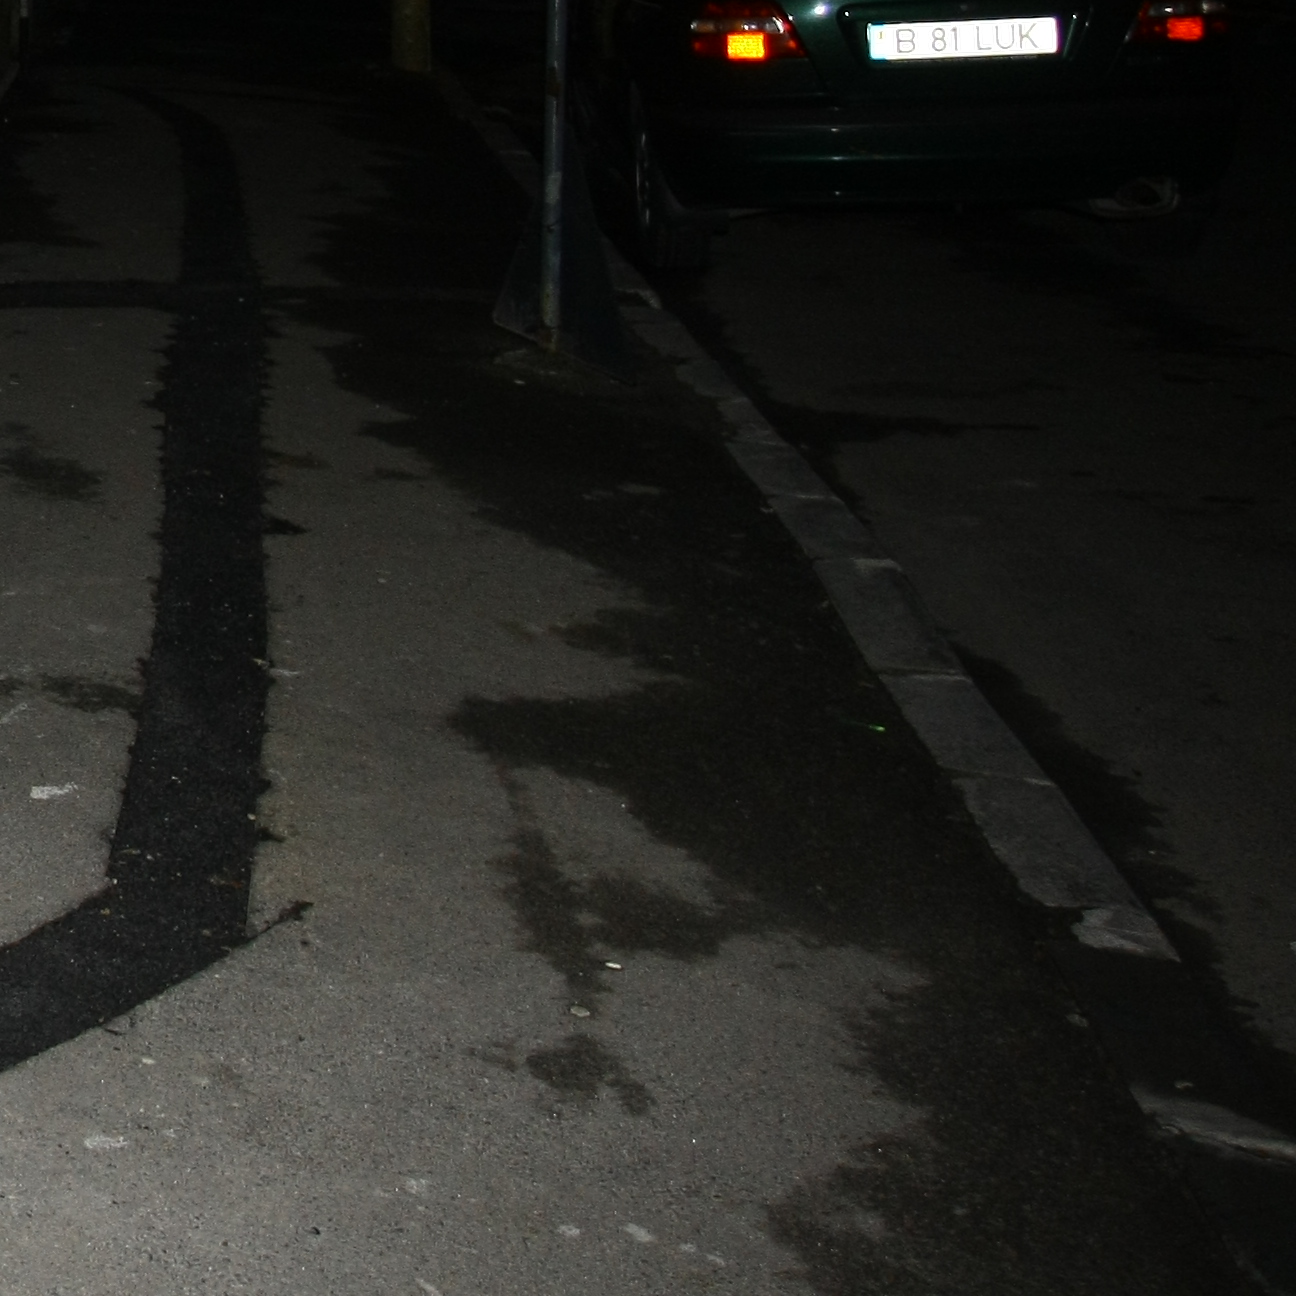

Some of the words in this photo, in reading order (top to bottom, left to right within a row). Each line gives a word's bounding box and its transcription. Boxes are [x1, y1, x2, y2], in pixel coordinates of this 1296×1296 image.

[895, 28, 915, 53] B
[931, 26, 959, 51] 81
[975, 23, 1039, 51] LUK
